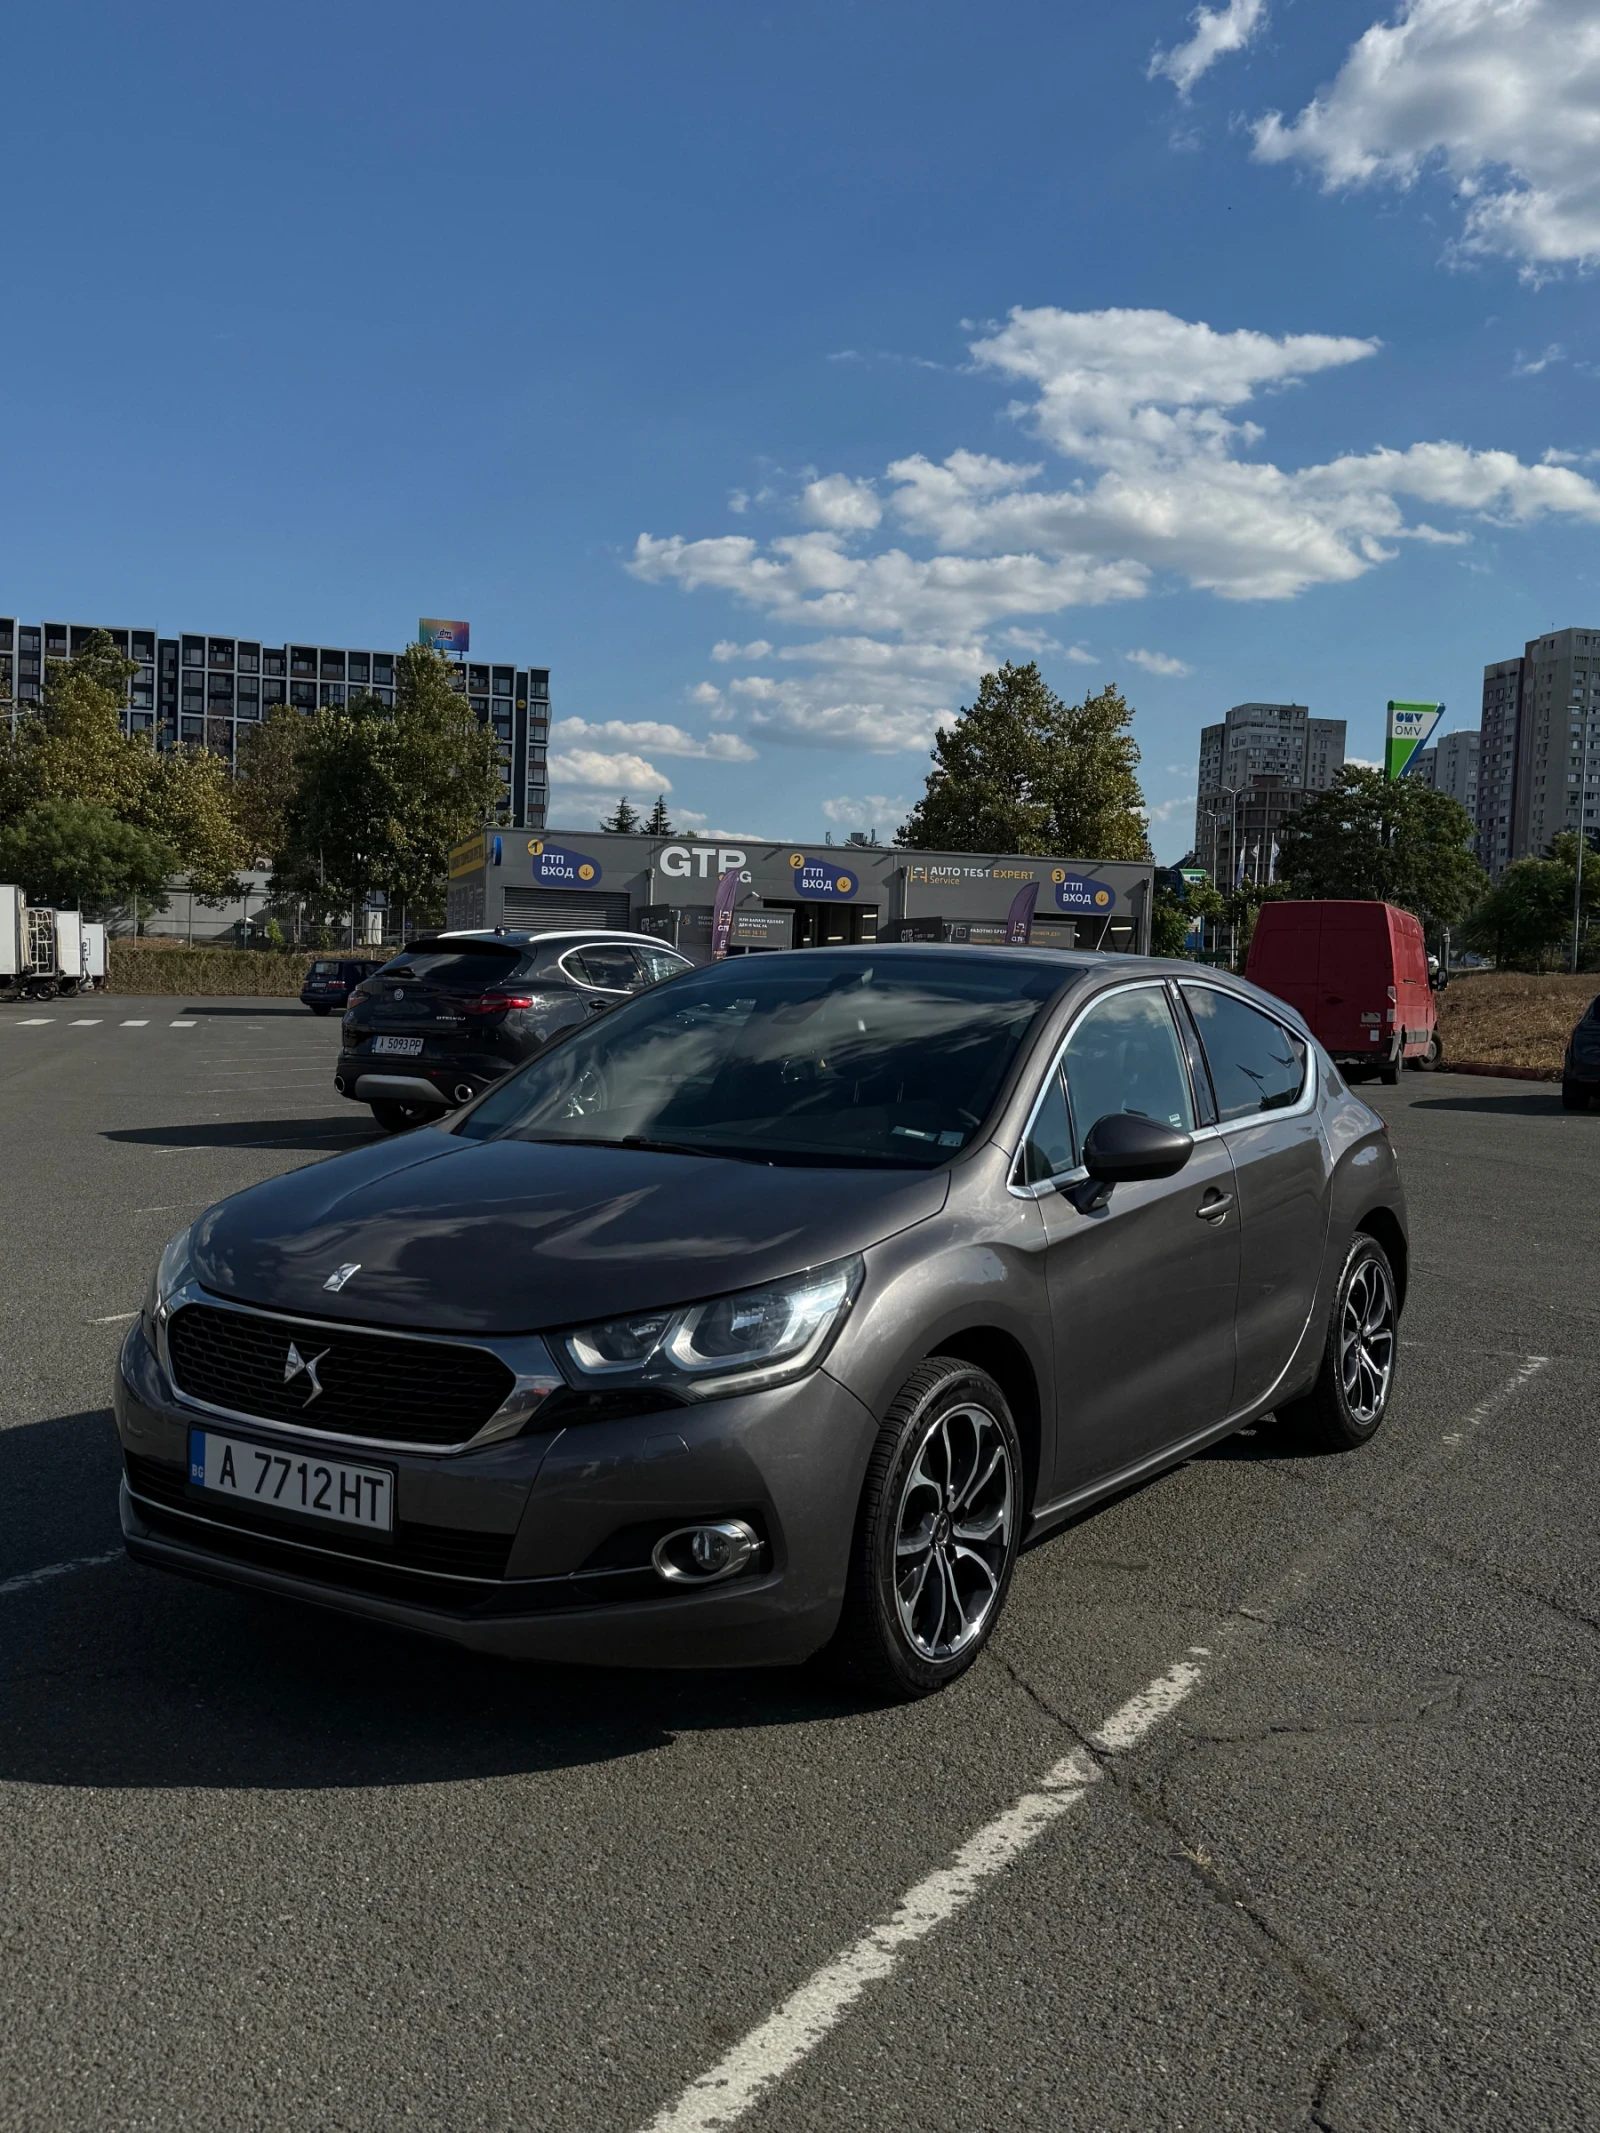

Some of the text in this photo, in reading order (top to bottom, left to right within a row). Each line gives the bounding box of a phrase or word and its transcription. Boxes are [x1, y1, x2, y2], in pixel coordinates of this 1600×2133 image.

[1394, 725, 1422, 736] OMV
[531, 841, 538, 853] 1
[542, 854, 564, 865] ГТП
[660, 846, 747, 878] GTP
[793, 855, 802, 867] 2
[541, 866, 574, 879] ВХОД
[803, 867, 824, 877] ГТП
[930, 866, 1035, 880] AUTO TEST EXPERT
[1055, 870, 1062, 882] 3
[802, 879, 833, 892] ВХОД
[929, 875, 960, 885] Service
[1063, 882, 1083, 892] ГТП
[1062, 893, 1092, 905] ВХОД
[191, 1463, 204, 1478] BG
[219, 1444, 237, 1489] A
